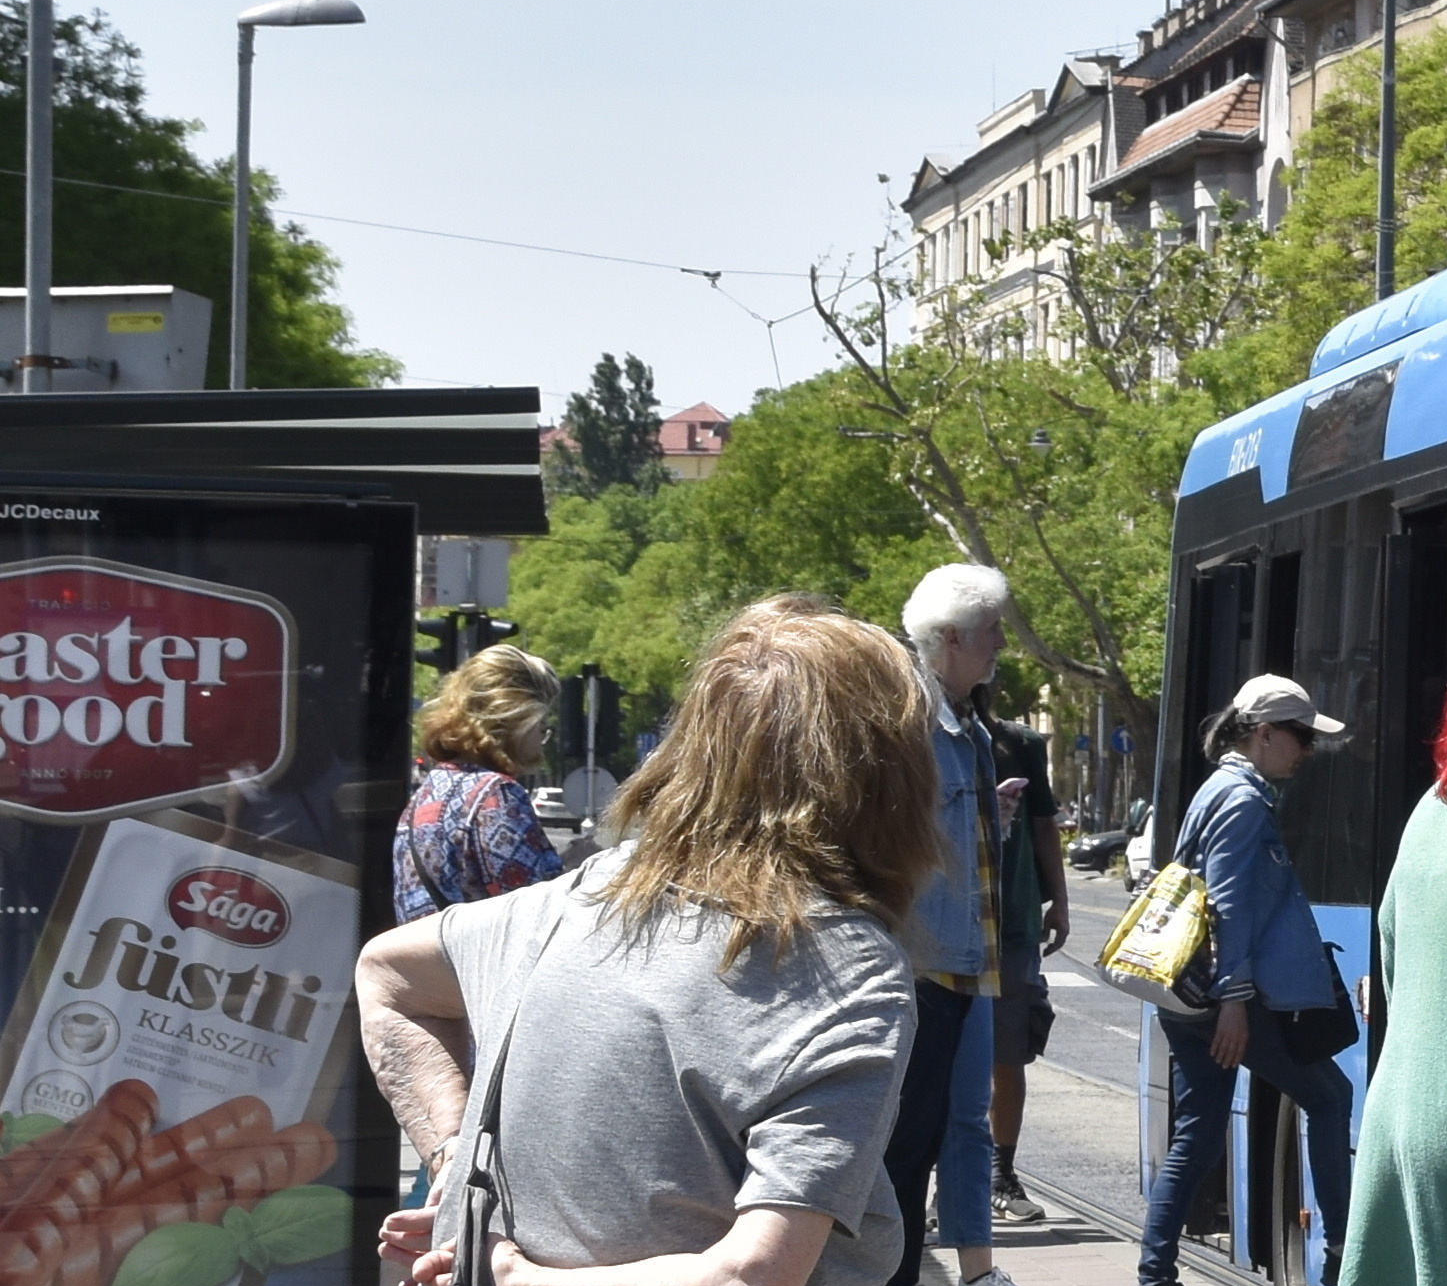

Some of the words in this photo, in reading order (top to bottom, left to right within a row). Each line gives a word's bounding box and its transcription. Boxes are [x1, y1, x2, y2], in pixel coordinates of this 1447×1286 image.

[0, 503, 101, 521] JCDecaux
[0, 679, 194, 760] ood
[176, 879, 279, 933] Sága
[62, 916, 323, 1044] füstli
[137, 1008, 281, 1067] KLASSZIK
[36, 1081, 86, 1108] GMO
